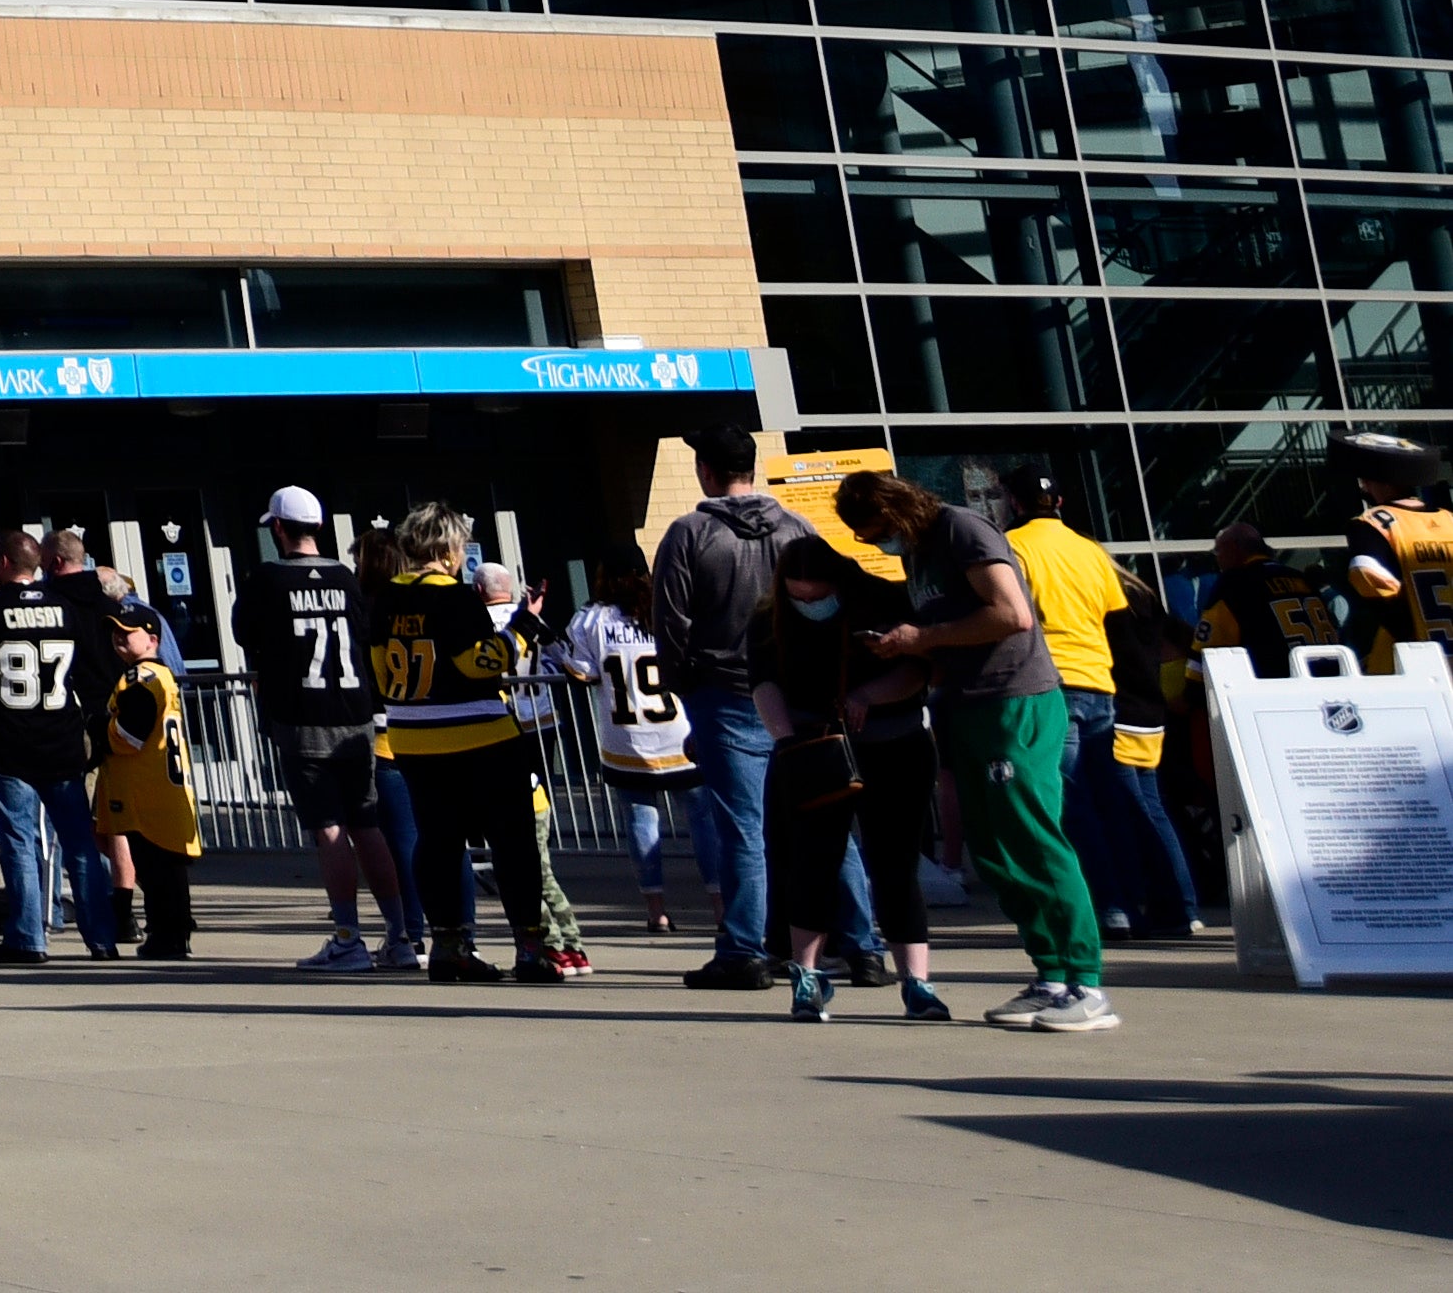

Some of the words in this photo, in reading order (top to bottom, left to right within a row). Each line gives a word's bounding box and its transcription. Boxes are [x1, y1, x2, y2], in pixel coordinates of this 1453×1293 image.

[524, 356, 645, 388] HIGHMARK
[3, 605, 64, 630] CROSBY
[289, 589, 346, 613] MALKIN
[293, 616, 361, 689] 71
[385, 639, 436, 701] 87
[603, 655, 679, 725] 19
